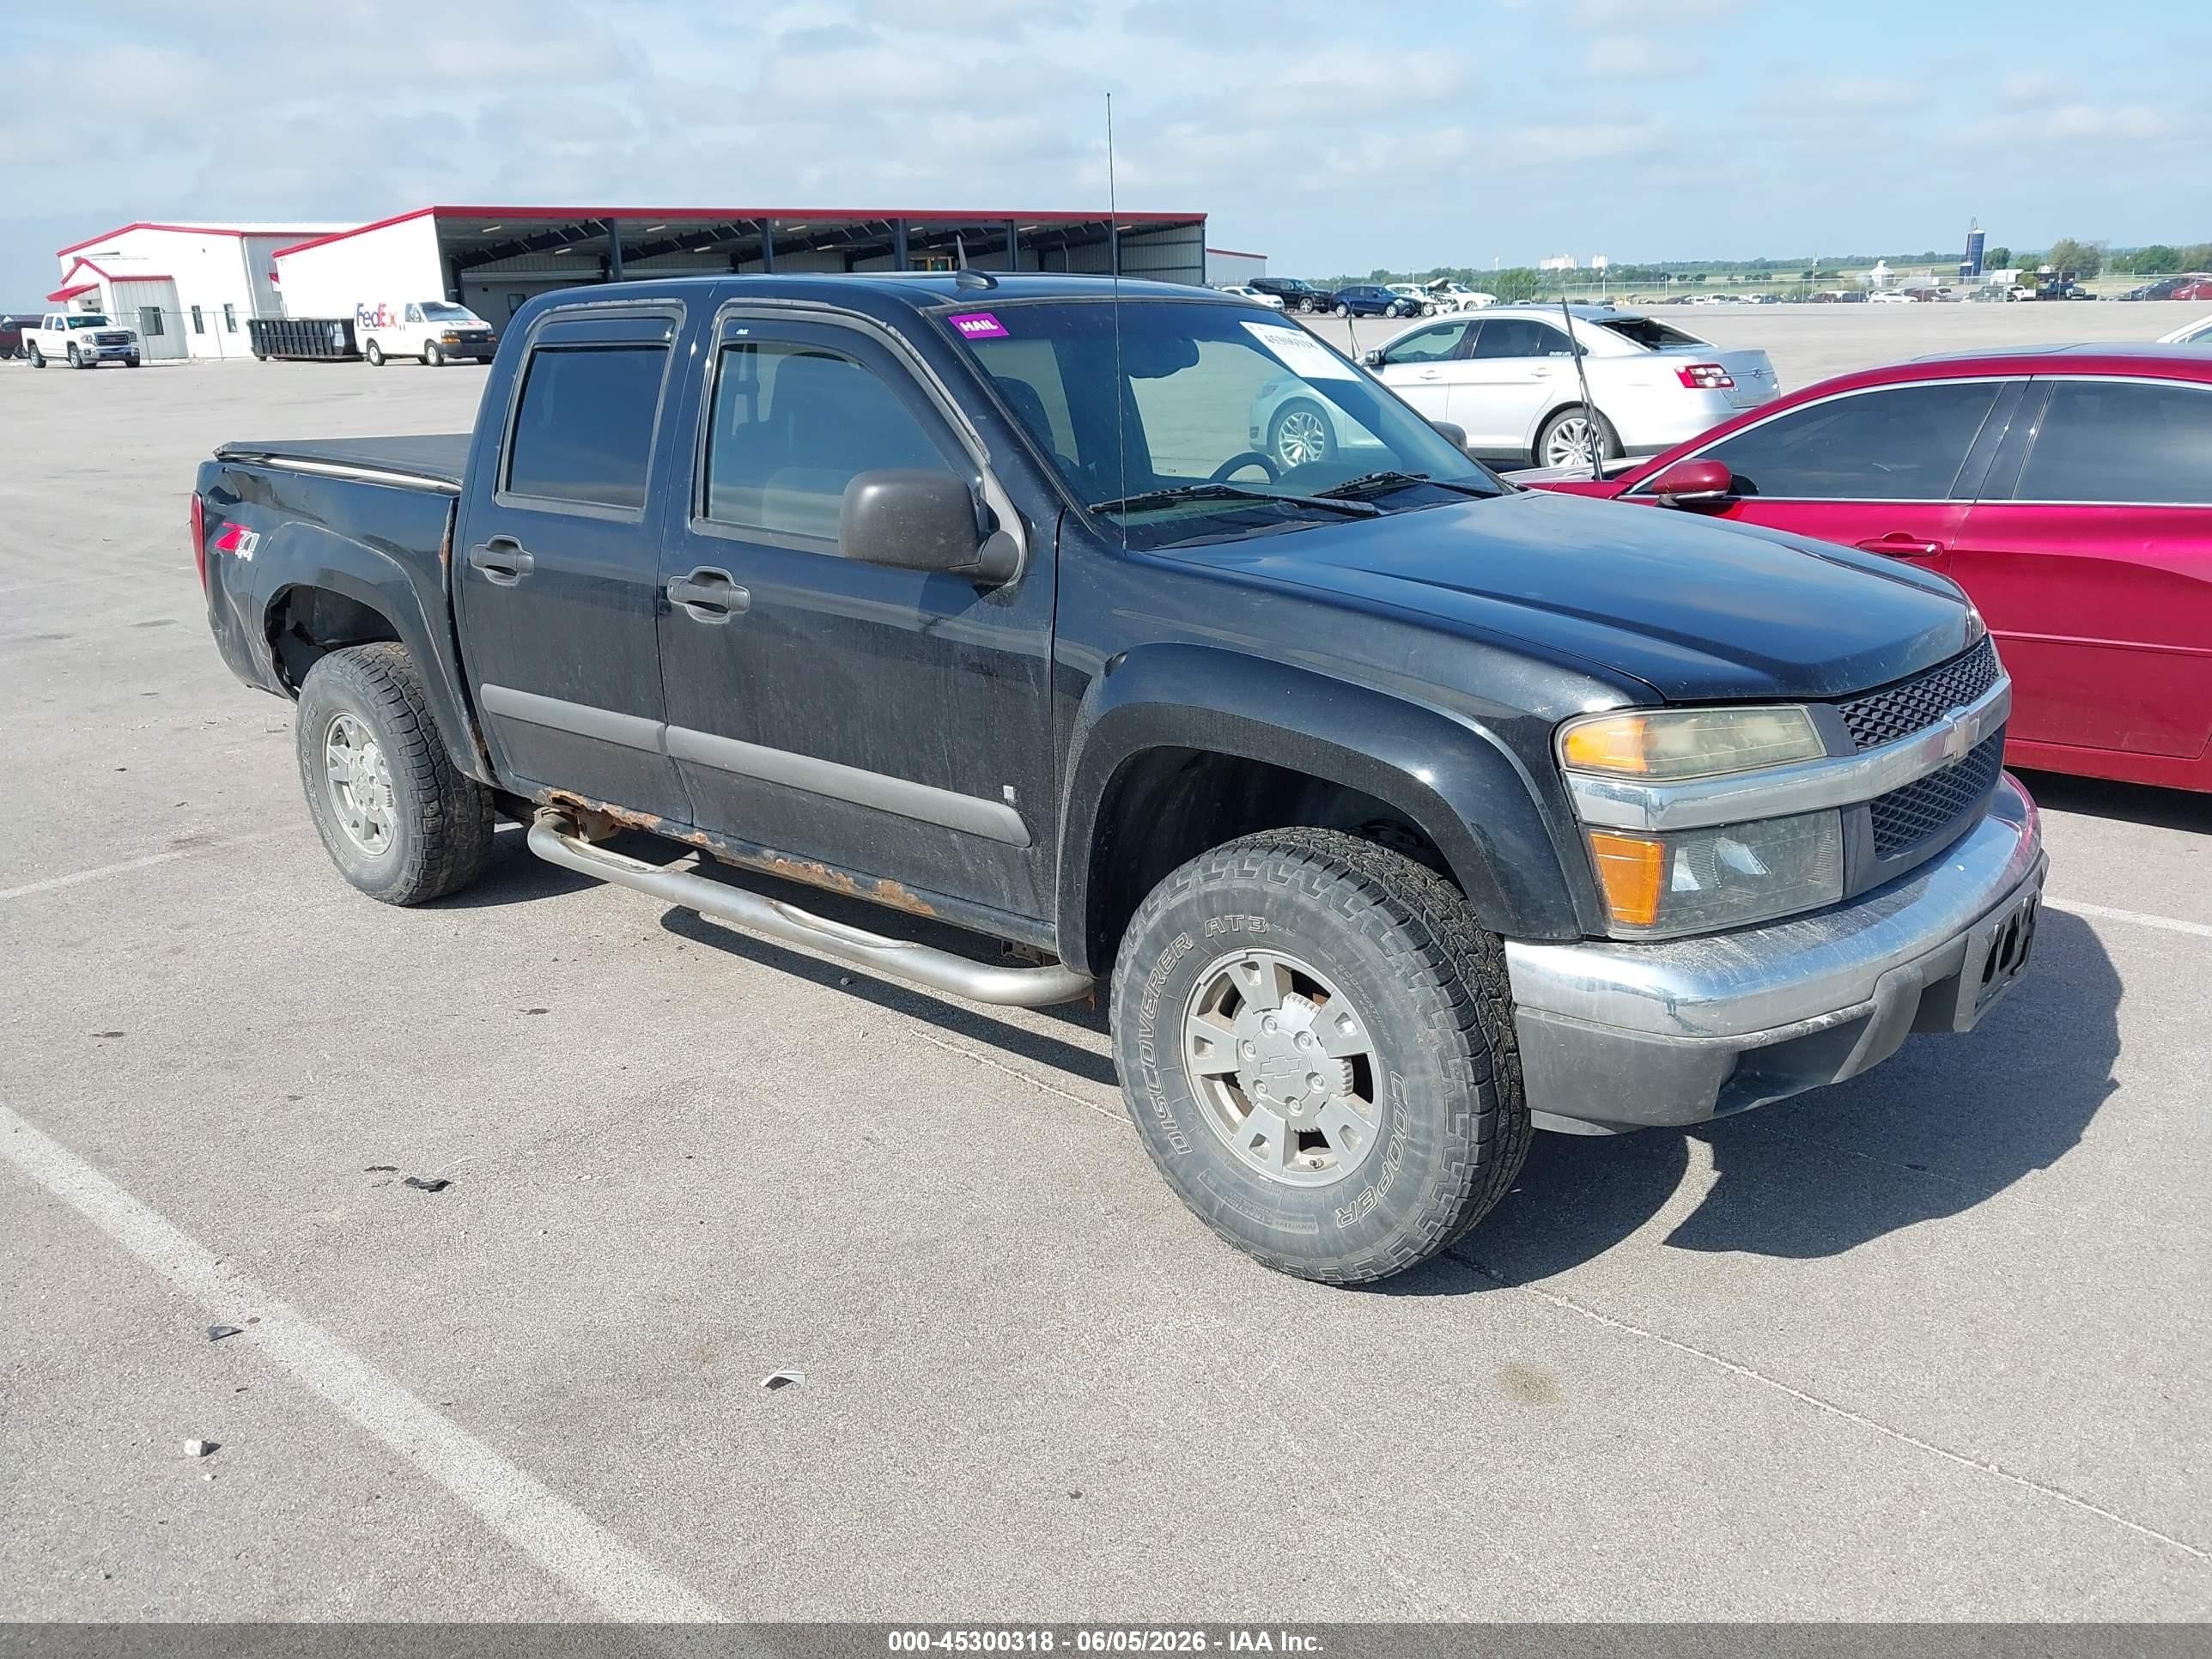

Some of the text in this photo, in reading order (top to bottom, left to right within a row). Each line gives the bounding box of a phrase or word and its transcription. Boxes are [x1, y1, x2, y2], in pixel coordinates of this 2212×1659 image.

[356, 302, 398, 328] FedEx
[959, 319, 999, 331] HAIL
[215, 522, 260, 552] Z71
[1139, 915, 1267, 1155] DISCOVERER AT3
[1336, 1071, 1408, 1229] COOPER
